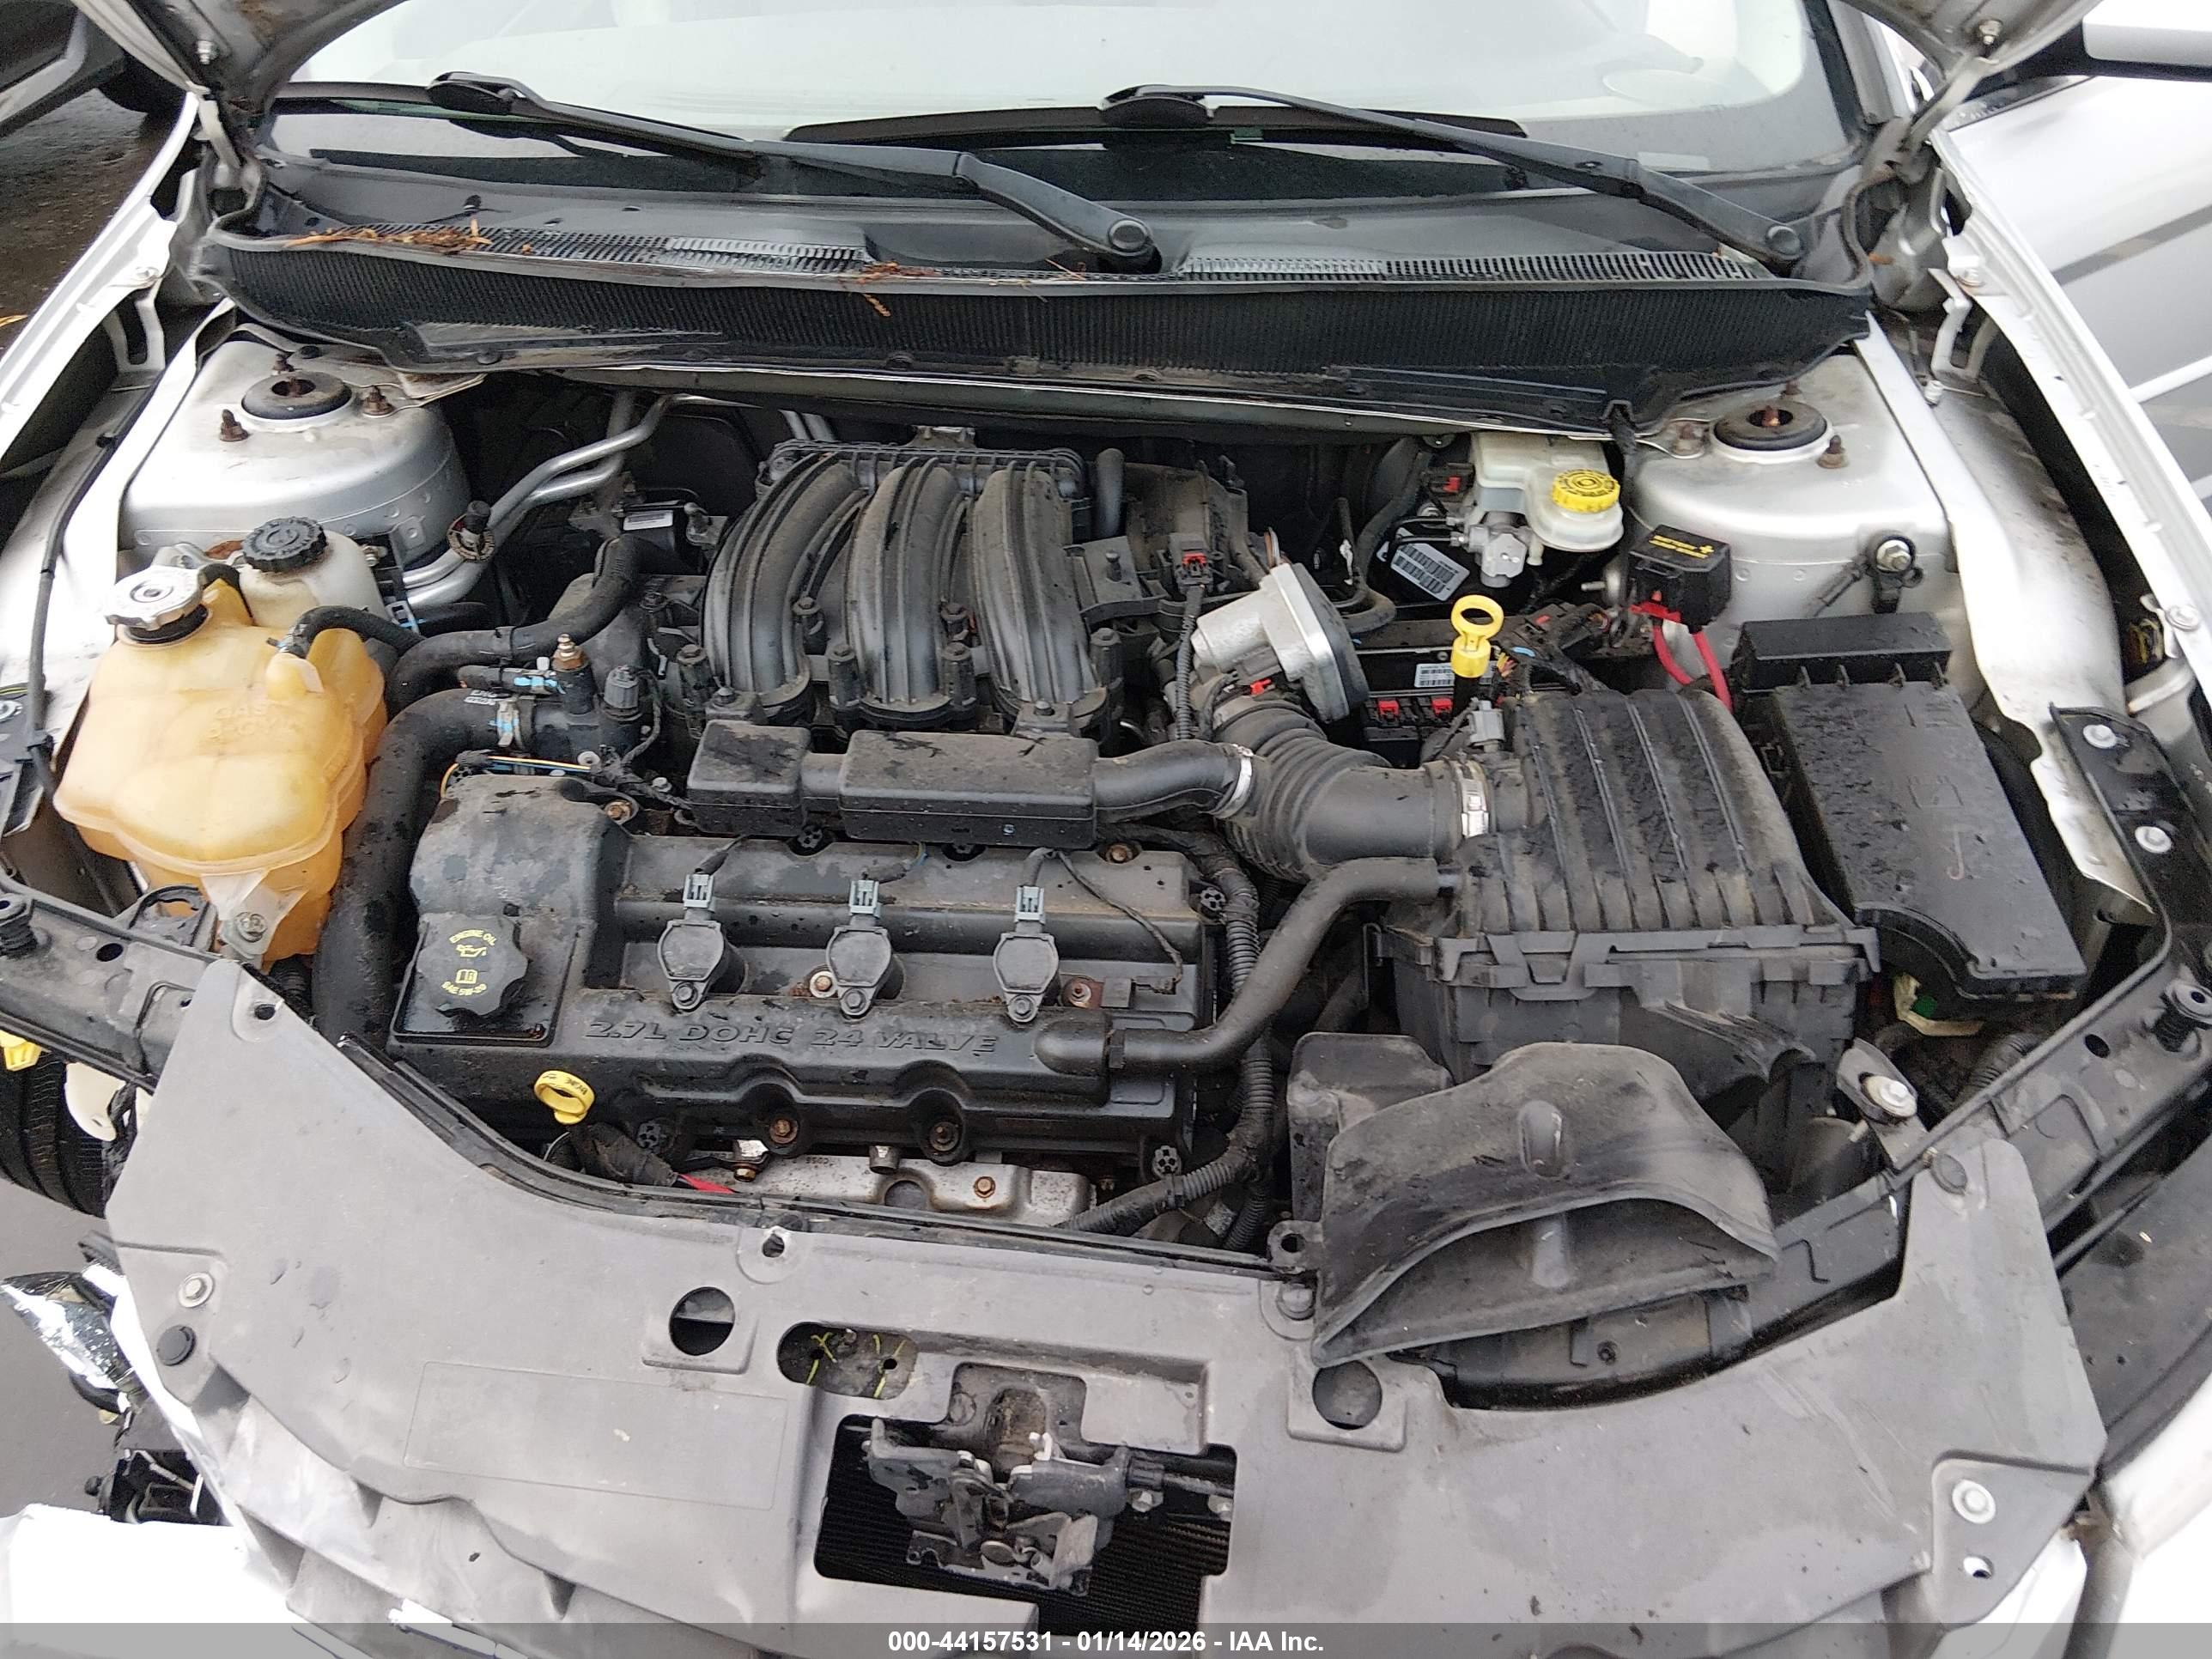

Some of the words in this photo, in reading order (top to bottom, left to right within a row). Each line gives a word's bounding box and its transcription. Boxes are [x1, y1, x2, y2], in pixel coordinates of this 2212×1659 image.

[586, 1021, 668, 1040] 2.7L
[678, 1024, 794, 1045] DOHC
[810, 1030, 864, 1047] 24
[877, 1032, 1000, 1053] VALVE
